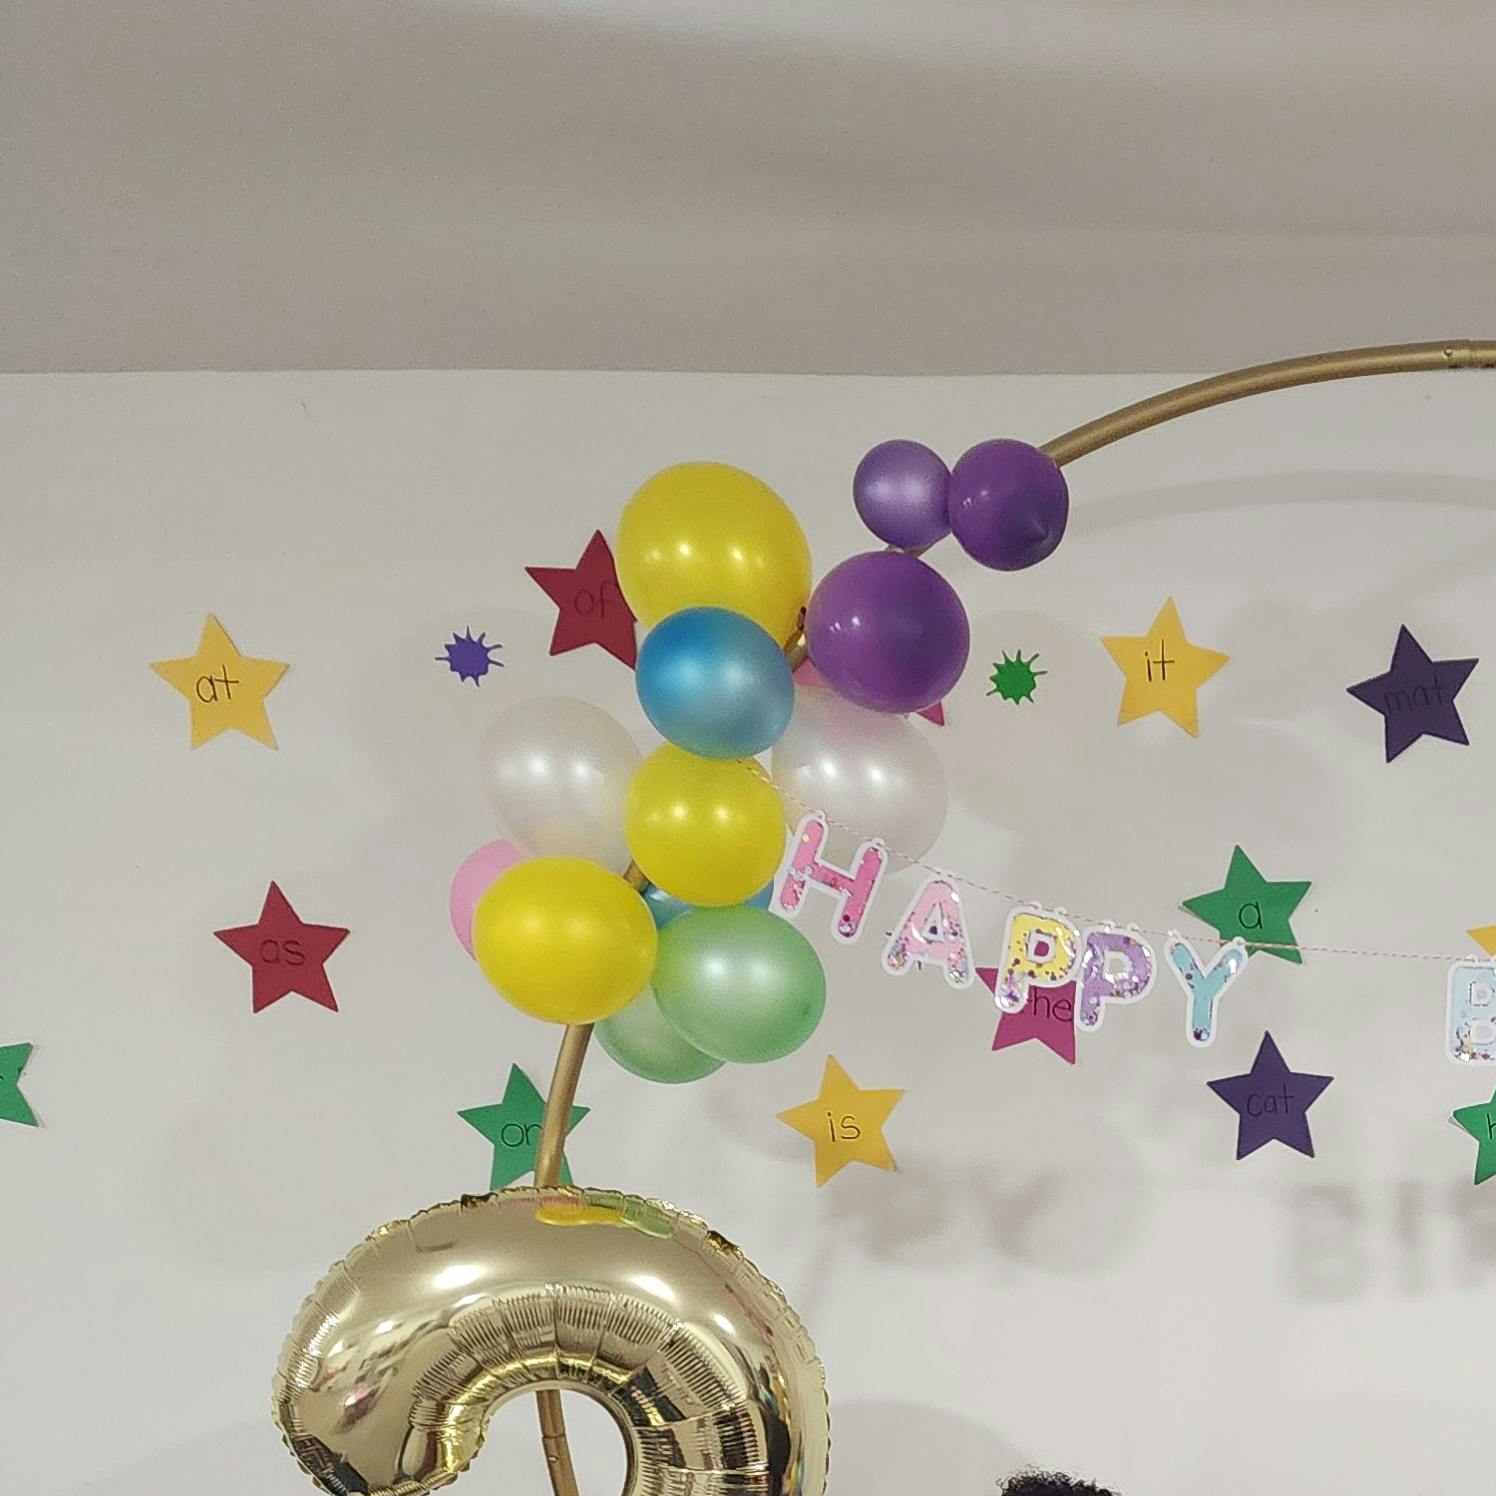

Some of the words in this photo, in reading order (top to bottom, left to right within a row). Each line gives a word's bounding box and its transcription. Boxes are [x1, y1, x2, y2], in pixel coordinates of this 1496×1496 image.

[1144, 639, 1175, 682] it
[195, 664, 239, 703] at
[769, 811, 1249, 1046] HAPPY
[1238, 901, 1263, 930] a
[260, 938, 306, 966] as
[1246, 1081, 1295, 1118] cat
[827, 1111, 861, 1142] is
